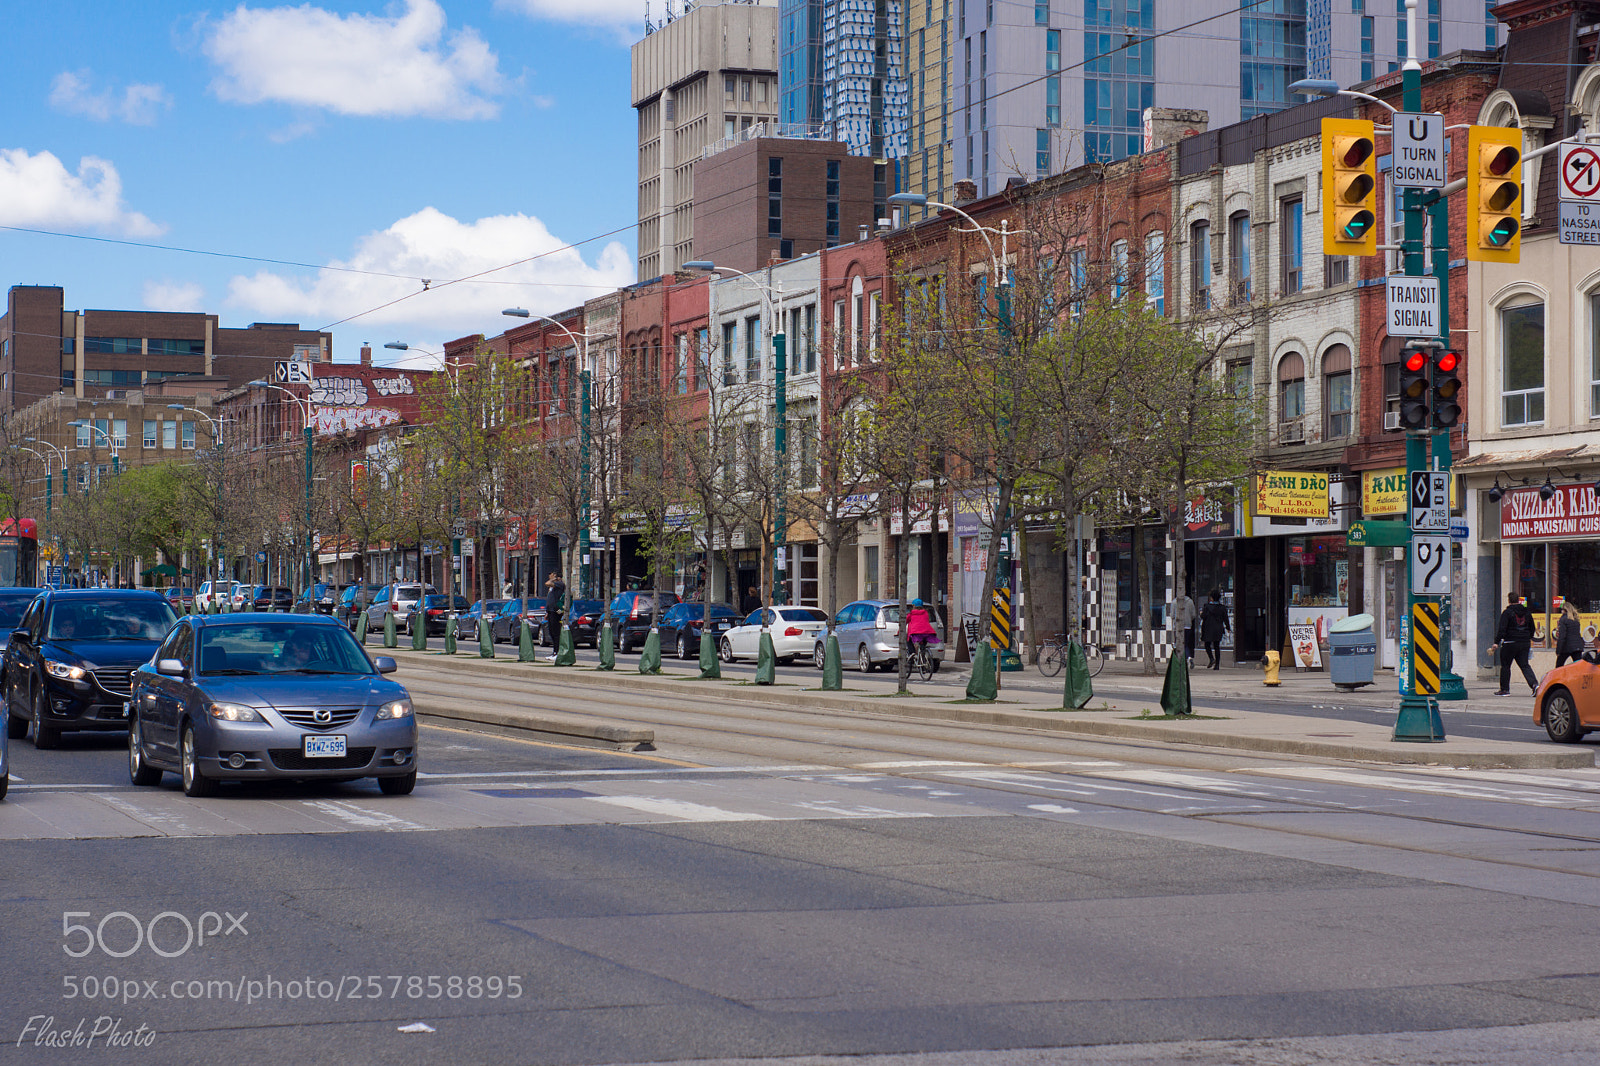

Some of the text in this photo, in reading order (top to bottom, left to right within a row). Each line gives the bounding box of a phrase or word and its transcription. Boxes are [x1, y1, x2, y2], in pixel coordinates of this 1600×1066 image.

[1408, 119, 1428, 141] U
[1402, 147, 1436, 161] TURN
[1396, 166, 1442, 181] SIGNAL
[1577, 205, 1590, 216] TO
[1390, 286, 1436, 304] TRANSIT
[1394, 309, 1433, 327] SIGNAL
[1283, 507, 1325, 516] 416-598-4514
[1429, 519, 1447, 527] LANE
[1291, 627, 1314, 635] WE'RE
[330, 741, 344, 752] 695
